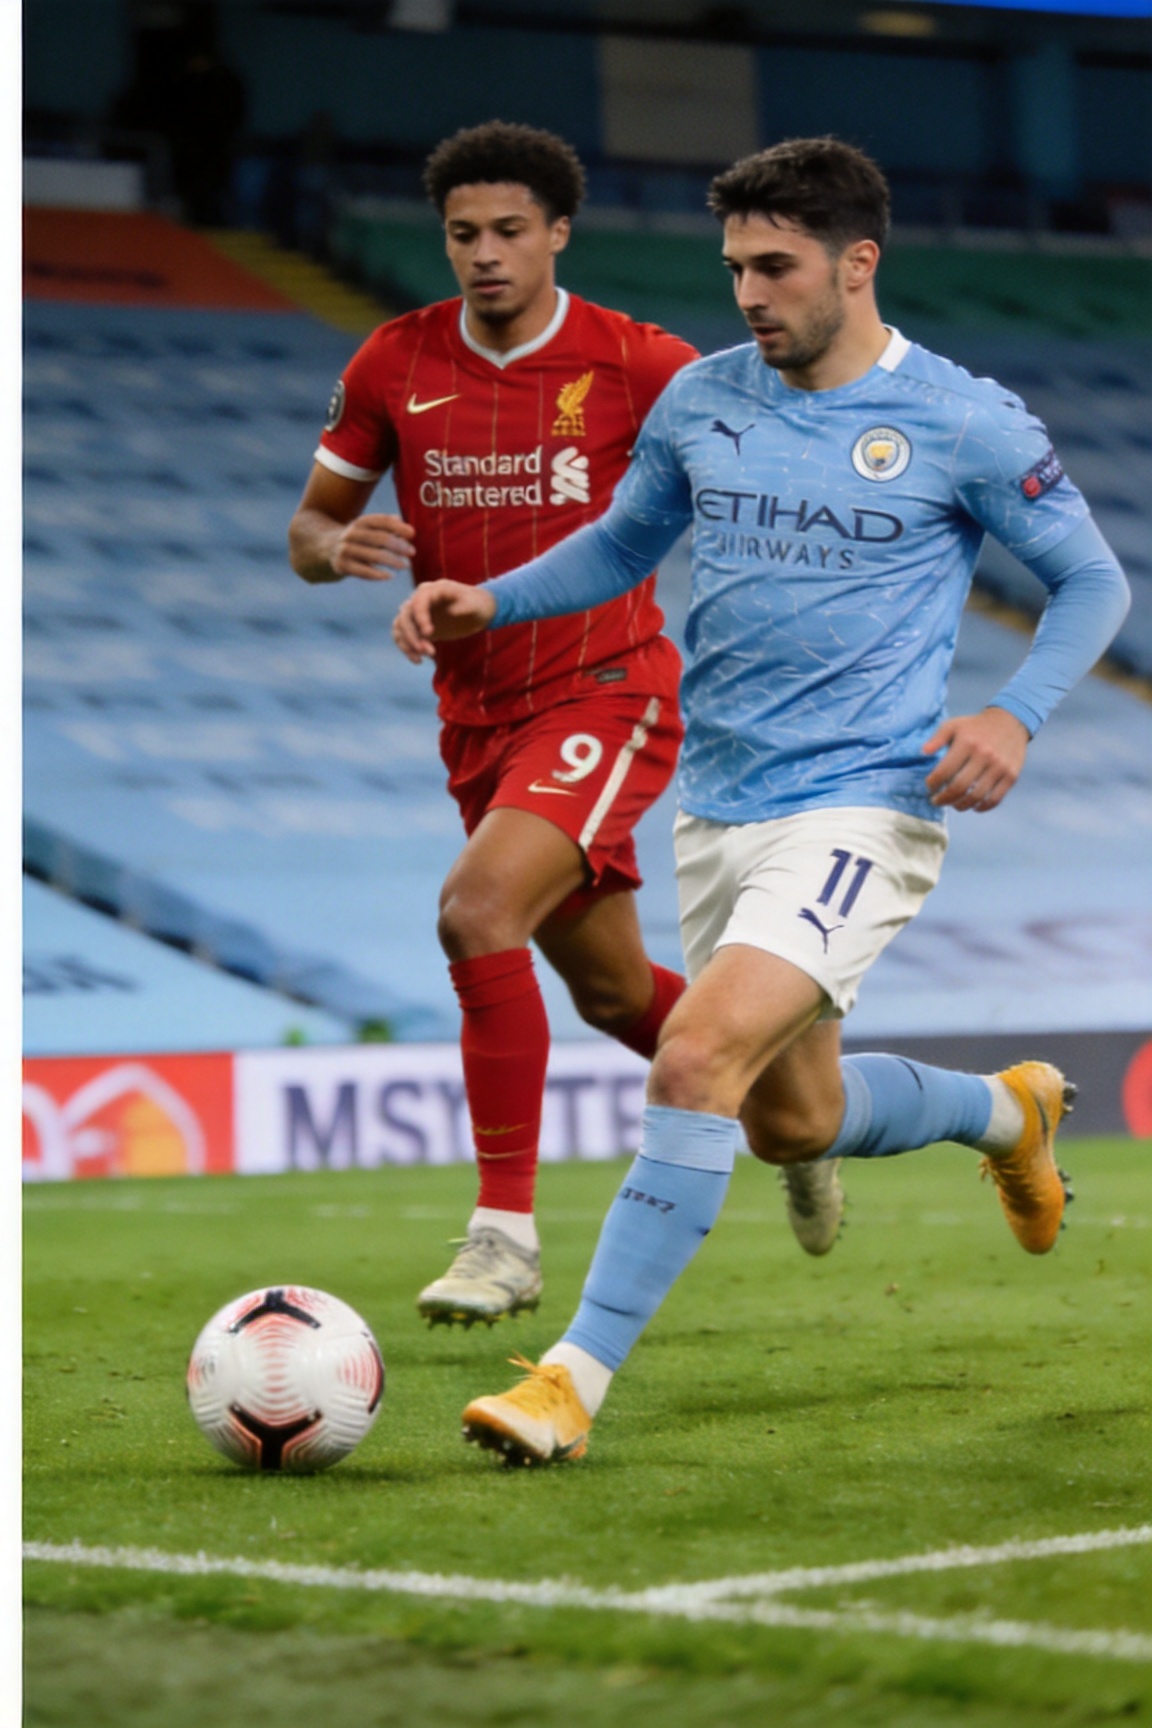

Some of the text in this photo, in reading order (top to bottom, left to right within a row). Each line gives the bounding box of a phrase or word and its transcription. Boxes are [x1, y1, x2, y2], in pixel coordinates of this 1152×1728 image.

[424, 445, 542, 477] Standard
[419, 479, 543, 508] Chartered
[696, 488, 904, 543] ETIHAD
[552, 733, 603, 783] 9
[816, 848, 874, 919] 11
